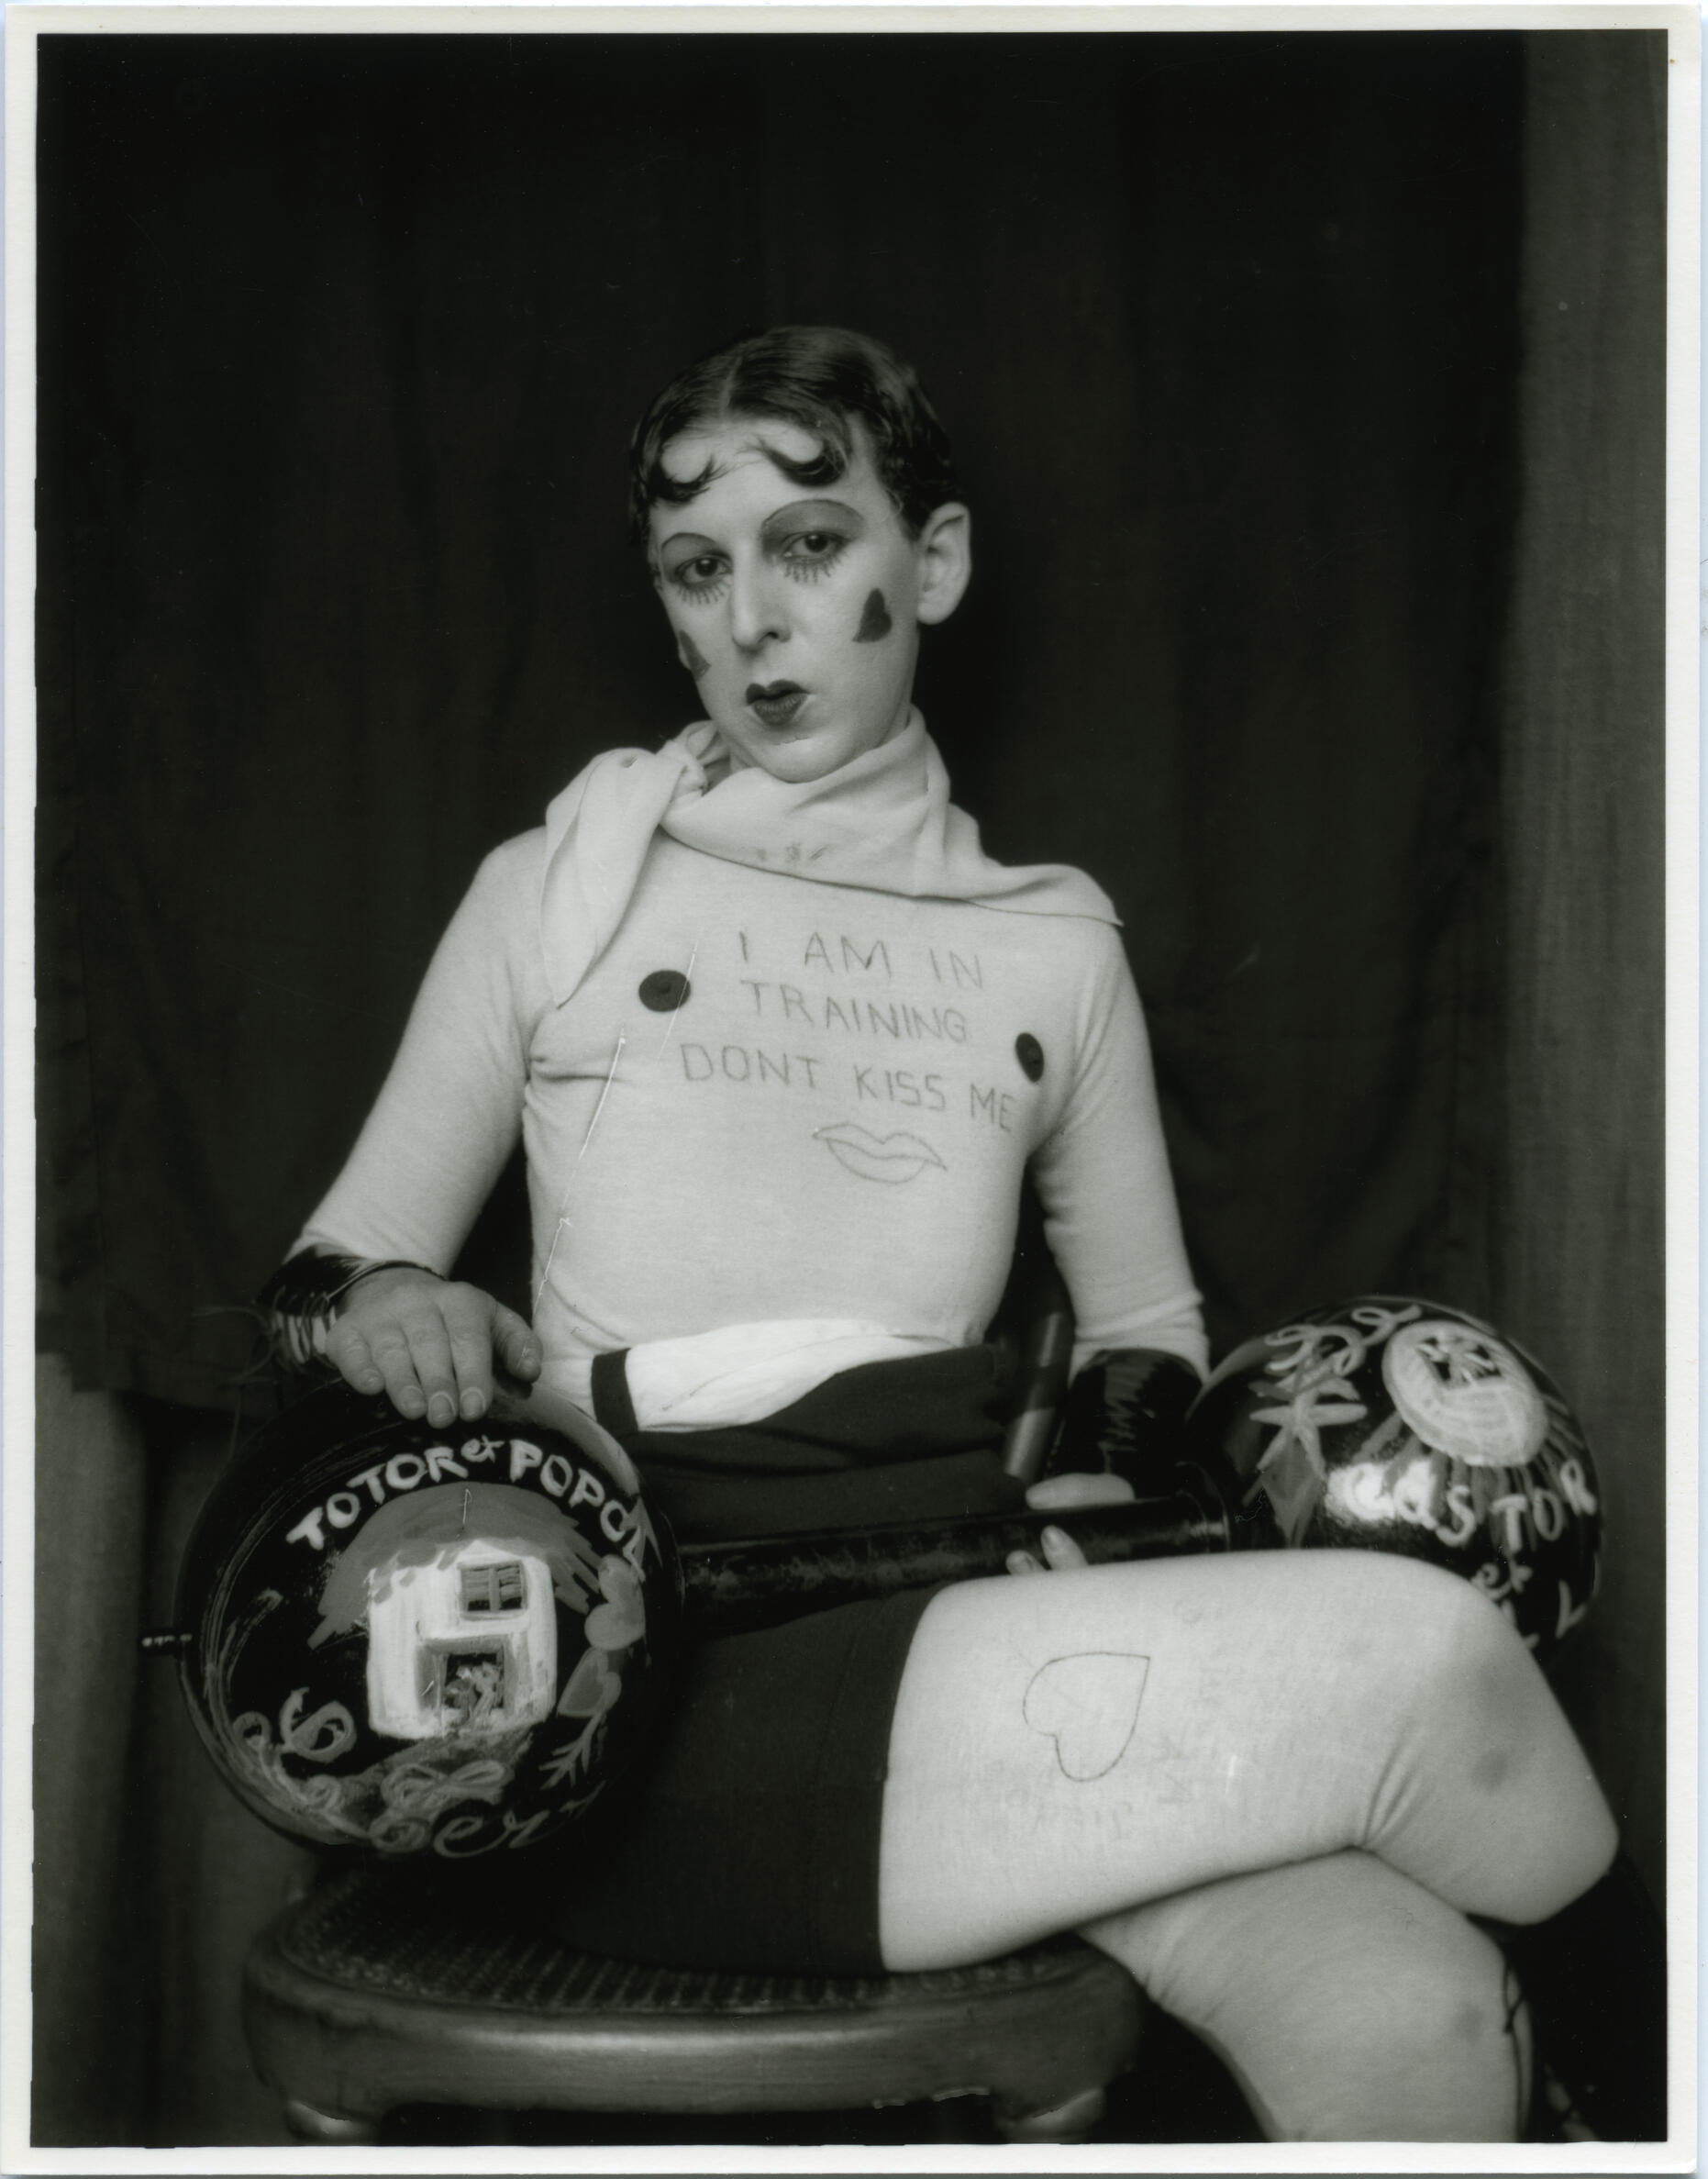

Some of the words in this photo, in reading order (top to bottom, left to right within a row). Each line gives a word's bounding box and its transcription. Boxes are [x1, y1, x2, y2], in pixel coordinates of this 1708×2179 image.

[738, 929, 749, 963] I
[804, 931, 893, 979] AM
[929, 948, 984, 990] IN
[739, 978, 969, 1044] TRAINING
[680, 1042, 824, 1090] DONT
[853, 1064, 948, 1112] KISS
[969, 1082, 1016, 1134] ME
[284, 1445, 470, 1551] TOTOR
